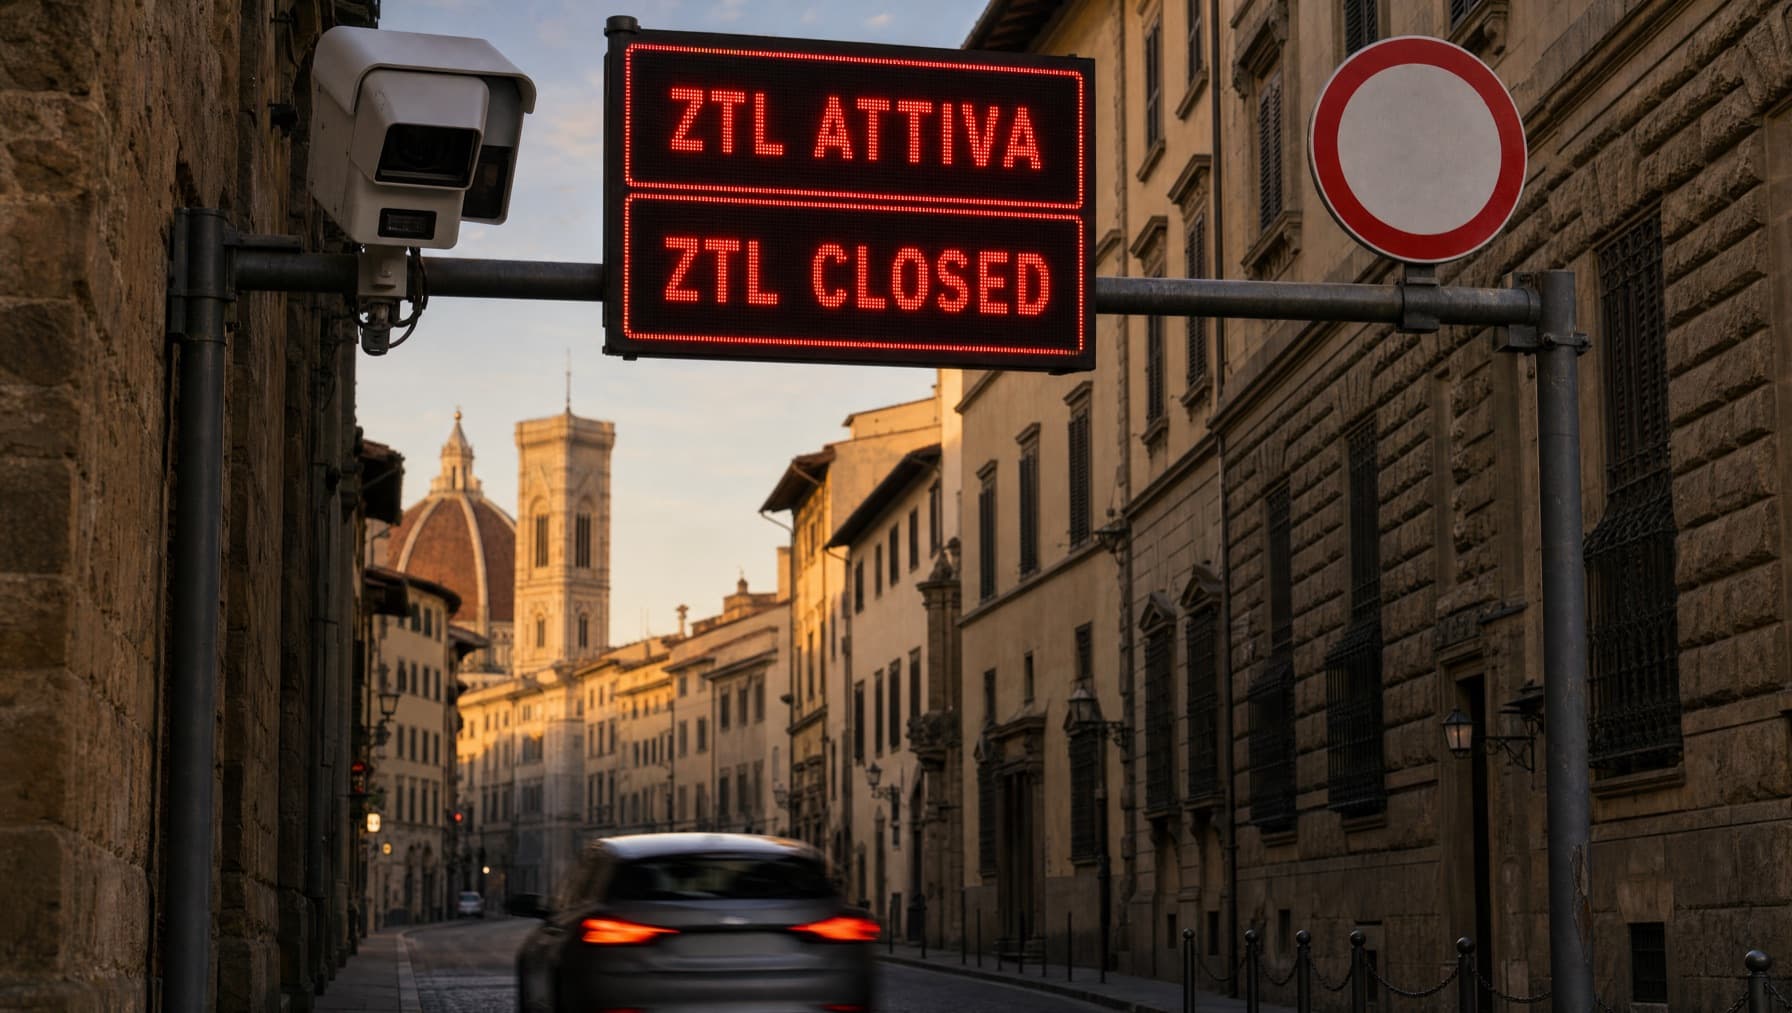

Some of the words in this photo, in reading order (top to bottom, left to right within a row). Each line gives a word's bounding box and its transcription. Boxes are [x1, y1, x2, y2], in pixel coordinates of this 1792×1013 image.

[671, 88, 784, 156] ZTL
[813, 96, 1041, 170] ATTIVA
[665, 237, 778, 305] ZTL
[812, 244, 1050, 316] CLOSED
